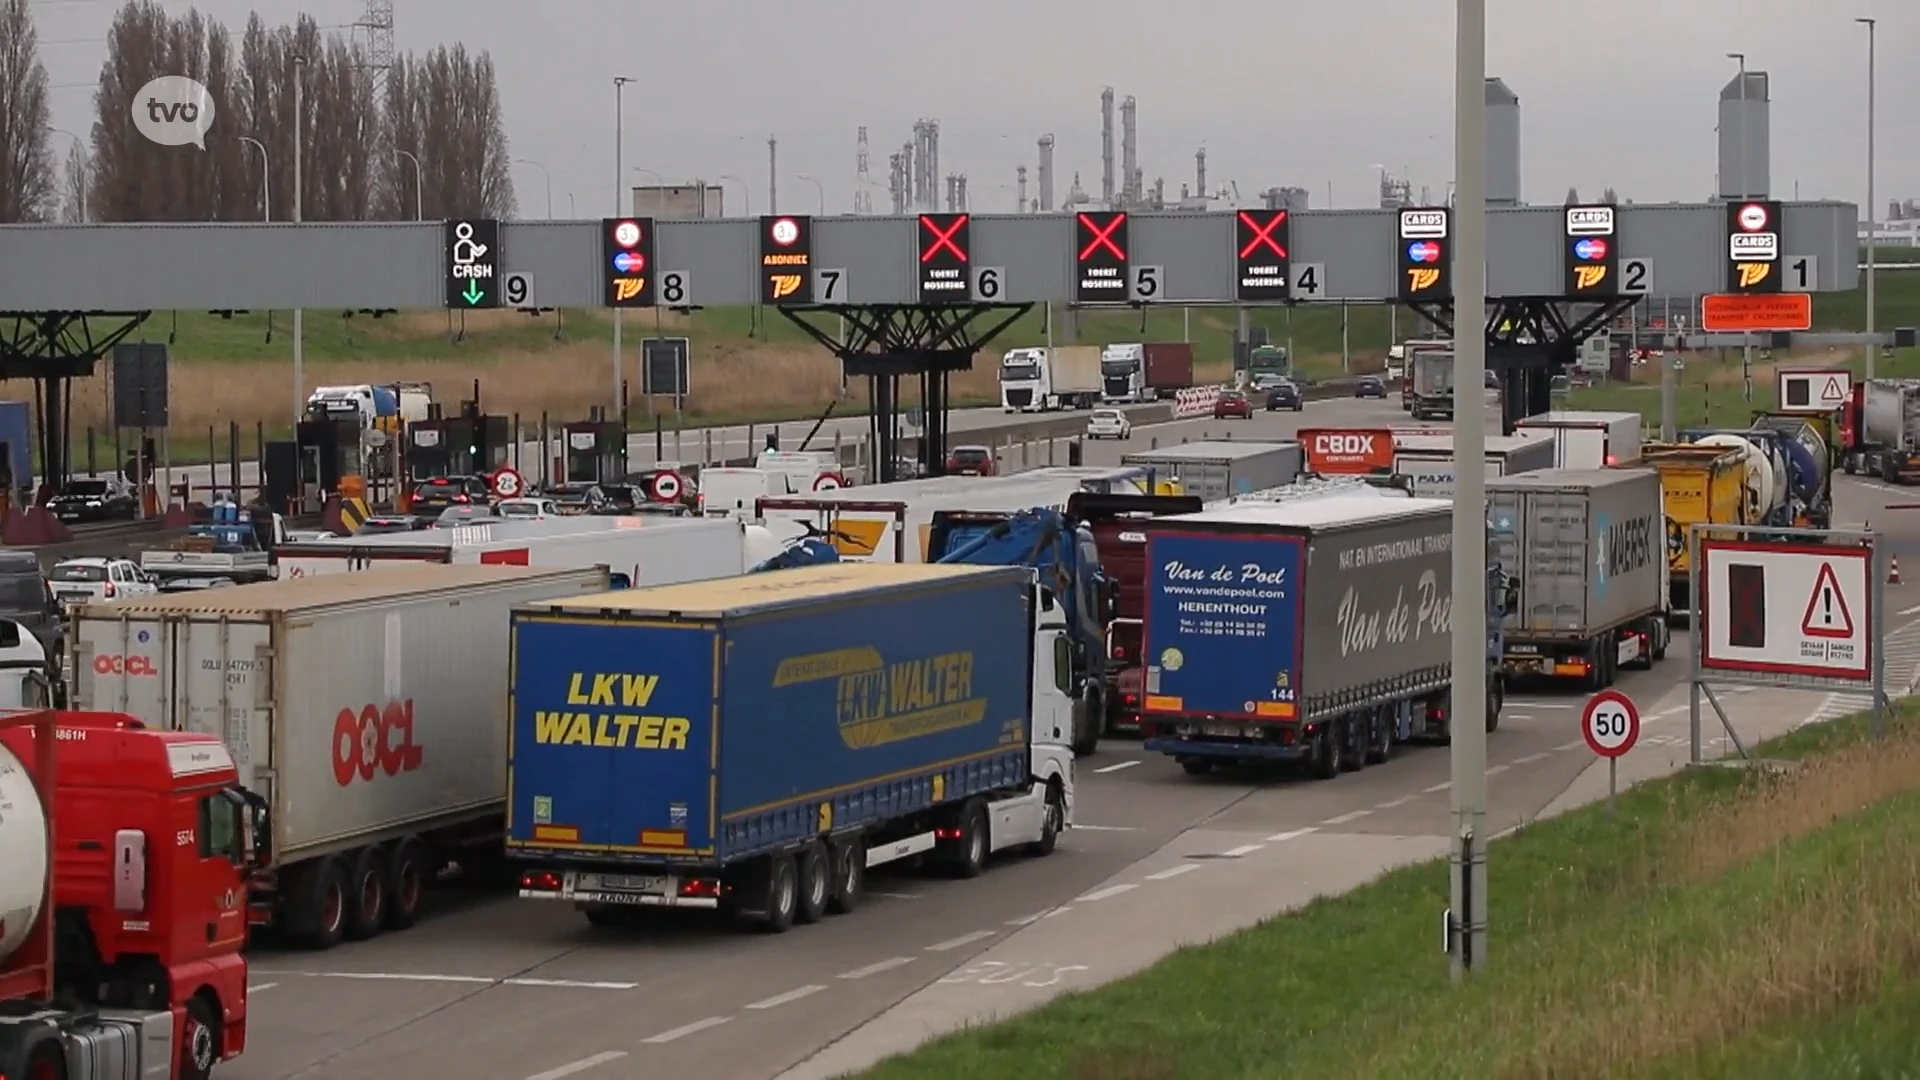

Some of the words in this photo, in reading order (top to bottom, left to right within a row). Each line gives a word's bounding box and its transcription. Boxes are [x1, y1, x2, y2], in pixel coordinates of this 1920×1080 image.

[1405, 214, 1442, 225] CARDS
[1571, 211, 1610, 223] CARDS
[1733, 236, 1774, 248] CARDS
[453, 264, 492, 278] CASH
[820, 271, 840, 299] 7
[978, 269, 999, 298] 6
[1136, 268, 1157, 297] 5
[1296, 266, 1318, 294] 4
[1625, 262, 1647, 291] 2
[1793, 259, 1806, 287] 1
[507, 276, 527, 304] 9
[663, 274, 684, 302] 8
[1315, 435, 1374, 453] CBOX
[1609, 514, 1652, 577] MAERSK
[1164, 561, 1205, 580] Van
[1210, 565, 1233, 582] de
[1241, 563, 1286, 584] Poel
[1163, 586, 1285, 599] www.vandepoel.com
[1178, 602, 1267, 615] HERENTHOUT
[1337, 586, 1380, 658] Van
[1386, 586, 1409, 643] de
[567, 672, 659, 707] LKW
[837, 669, 887, 726] LKW
[889, 650, 973, 713] WALTER
[1271, 688, 1294, 700] 144
[535, 711, 690, 750] WALTER
[1597, 712, 1625, 736] 50
[332, 698, 423, 787] OOCL
